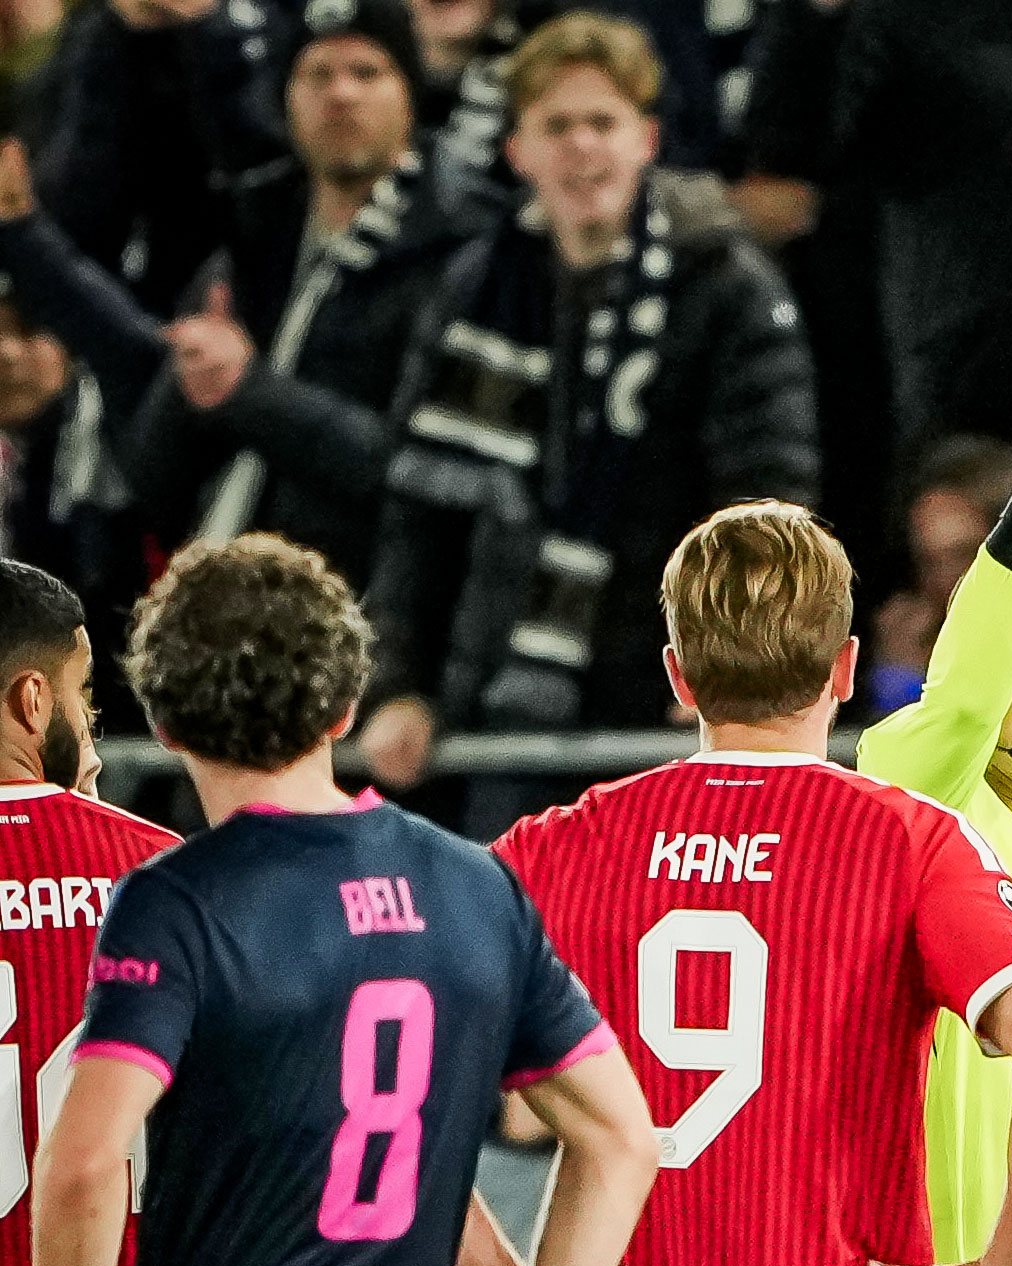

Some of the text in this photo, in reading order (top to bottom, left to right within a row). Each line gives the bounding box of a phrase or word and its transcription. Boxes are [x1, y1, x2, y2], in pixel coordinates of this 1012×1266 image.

[339, 875, 427, 936] BELL
[648, 831, 781, 883] KANE
[317, 977, 435, 1240] 8
[638, 909, 769, 1169] 9
